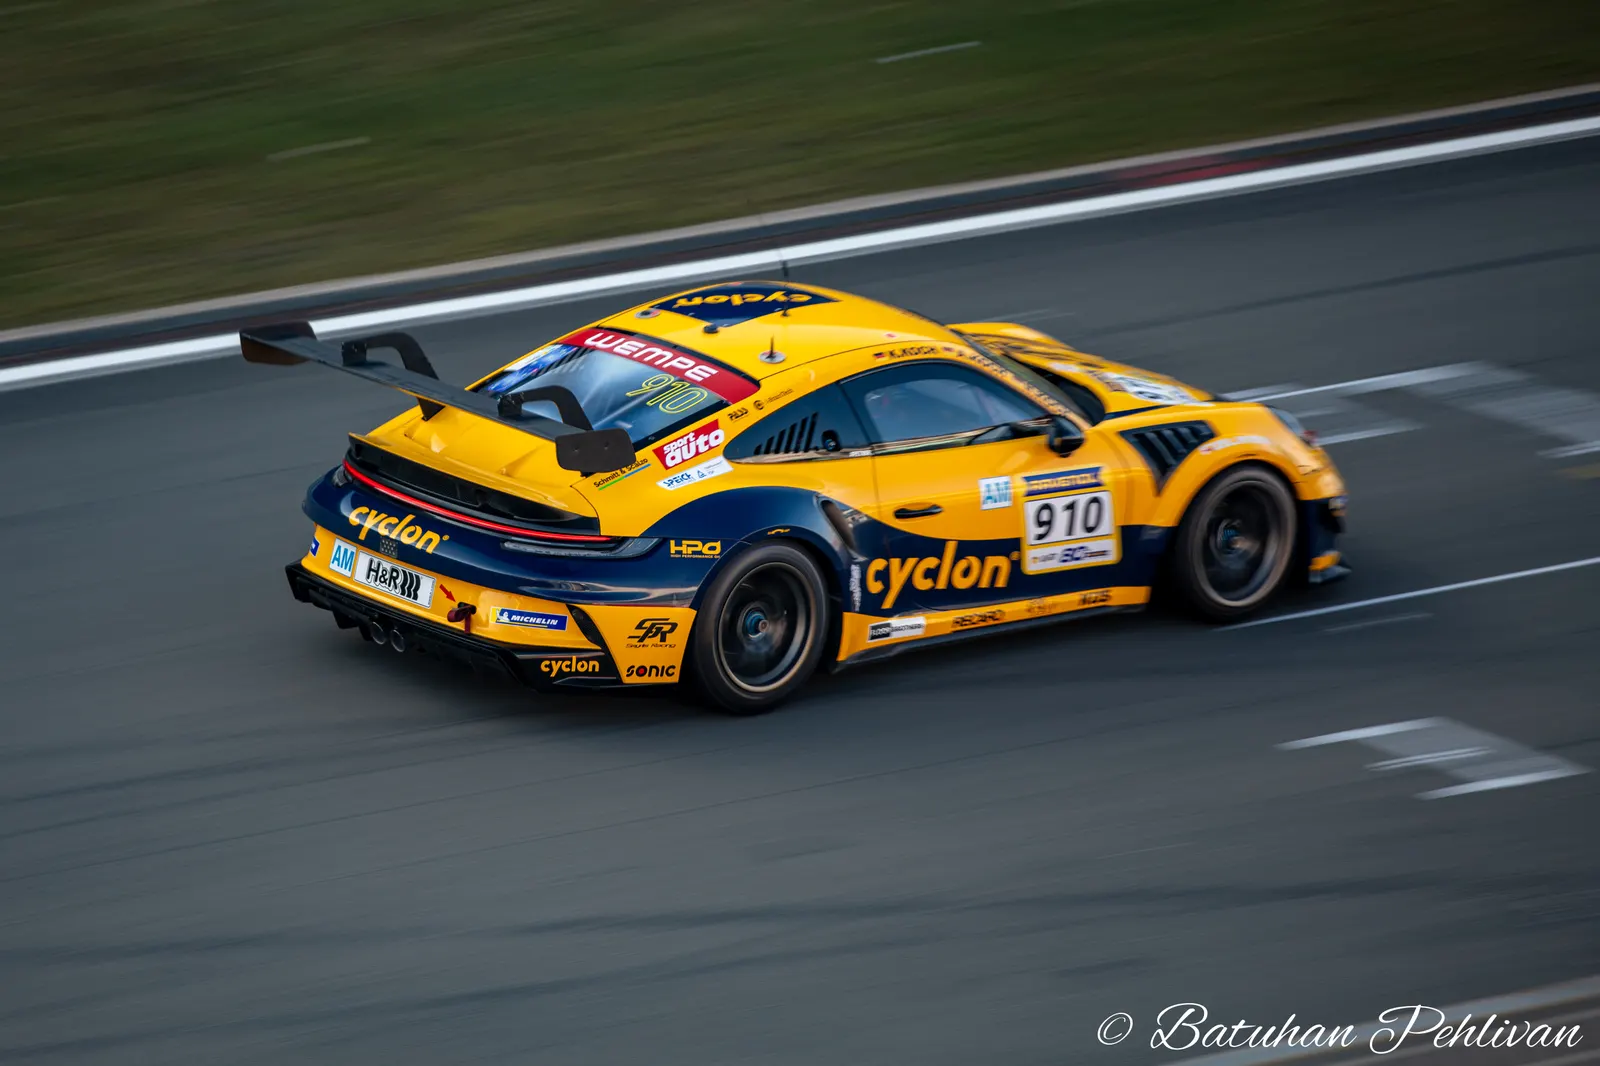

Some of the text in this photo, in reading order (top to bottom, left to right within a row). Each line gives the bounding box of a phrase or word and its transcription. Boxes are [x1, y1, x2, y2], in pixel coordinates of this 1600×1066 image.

[672, 291, 812, 308] cyclon
[584, 333, 718, 382] WEMPE
[626, 374, 708, 414] 910
[663, 431, 696, 455] sport
[665, 428, 725, 468] auto
[593, 470, 620, 488] Schmitt
[625, 458, 648, 475] Scalzo
[982, 480, 1010, 505] AM
[348, 506, 442, 555] cyclon
[1033, 496, 1104, 541] 910
[331, 545, 355, 572] AM
[366, 557, 400, 591] H&R
[866, 540, 1012, 609] cyclon
[511, 614, 559, 626] MICHELIN
[540, 656, 600, 678] cyclon
